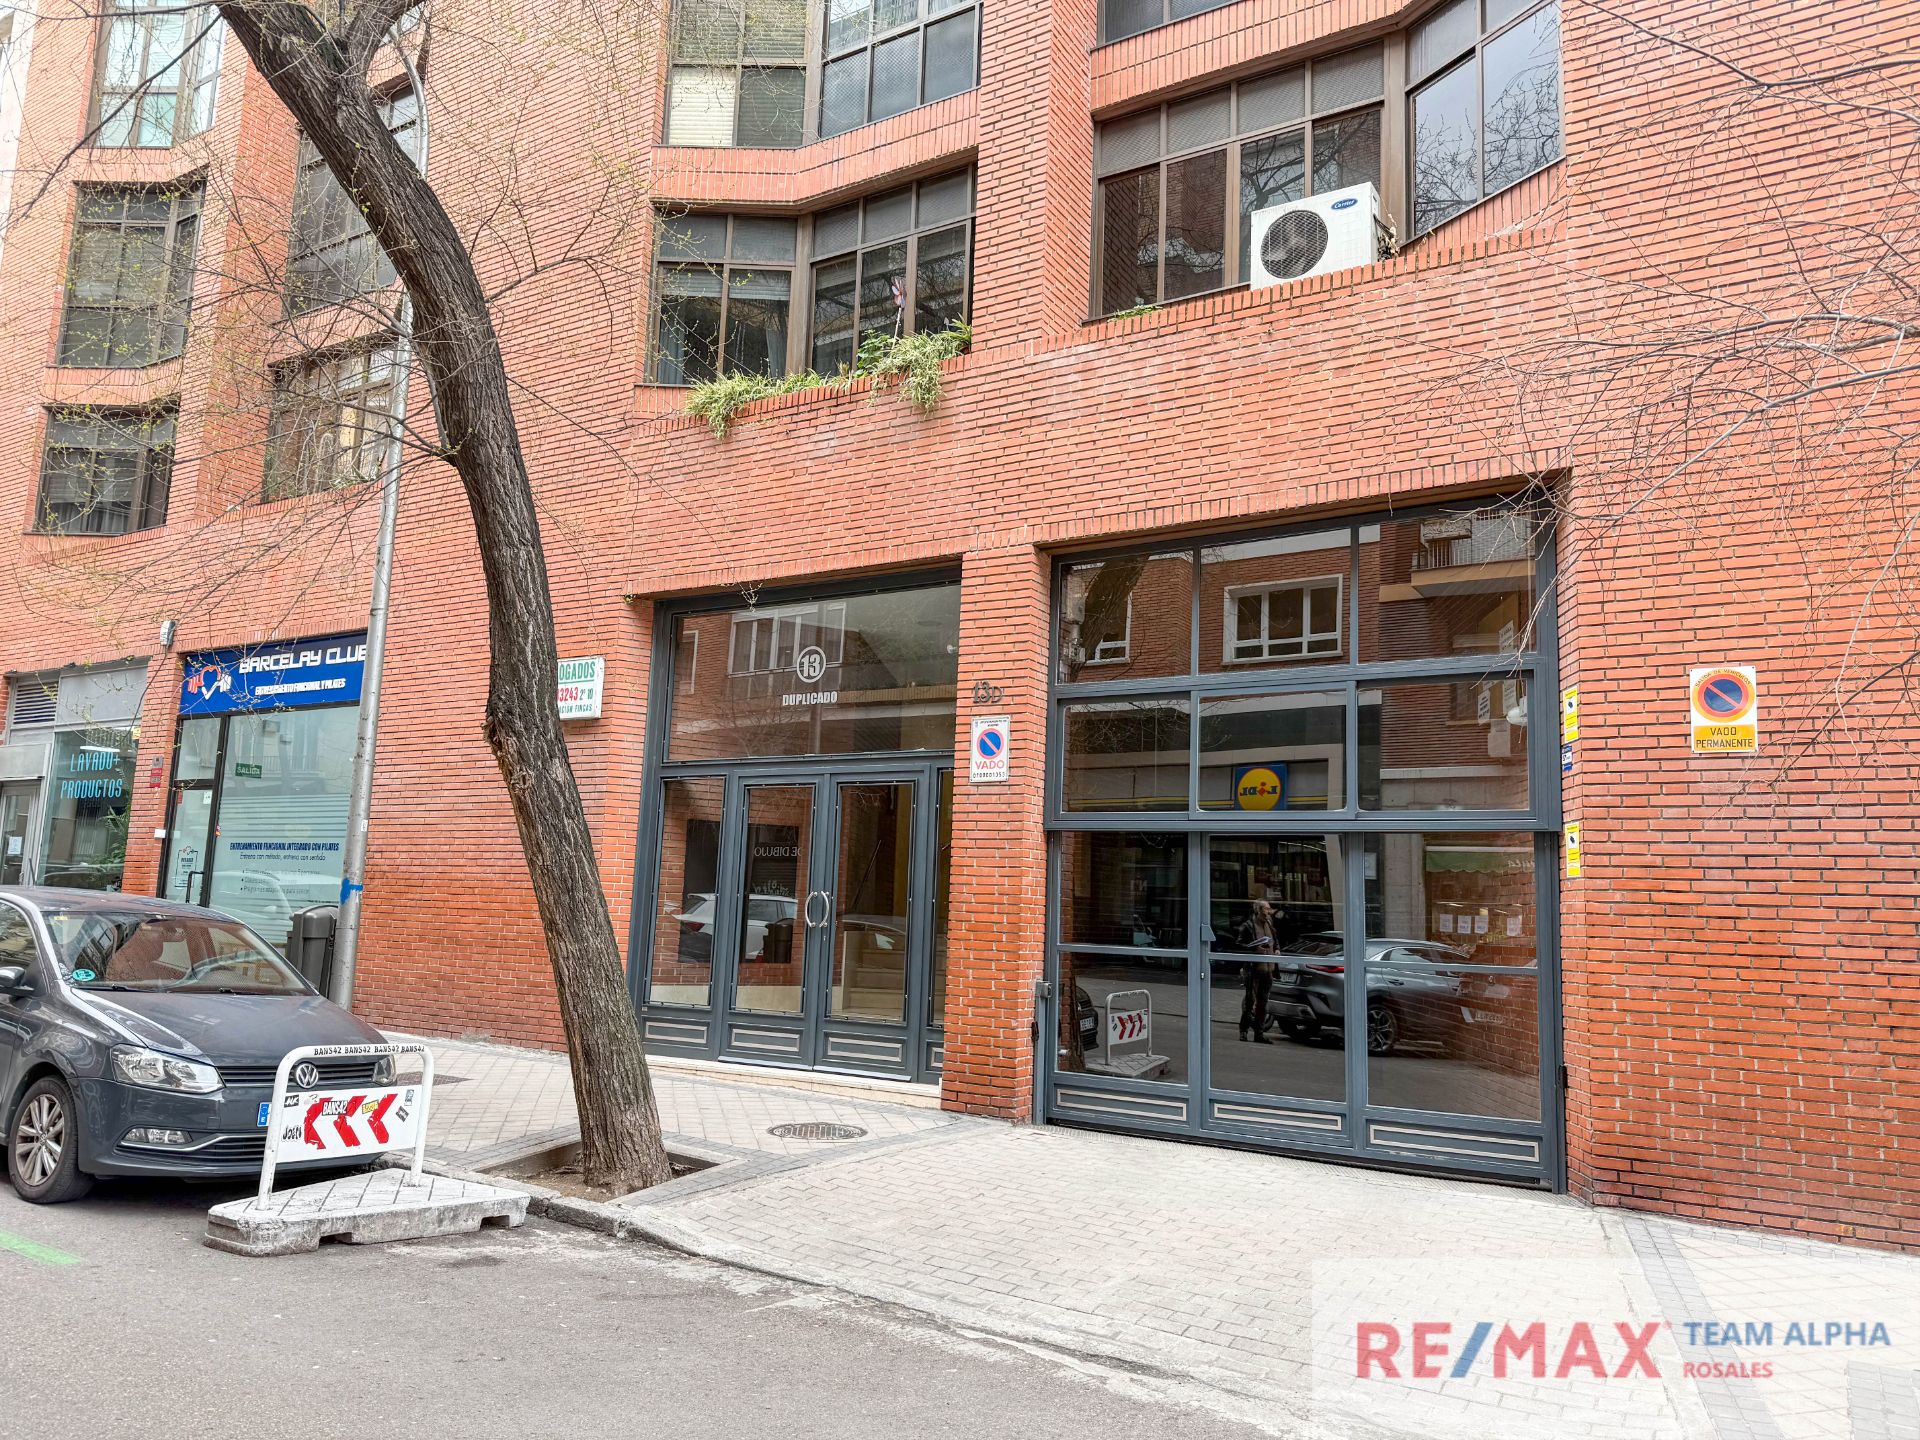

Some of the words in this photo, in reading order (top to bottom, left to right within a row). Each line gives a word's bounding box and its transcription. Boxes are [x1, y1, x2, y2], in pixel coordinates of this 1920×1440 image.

[238, 649, 322, 674] BARCELAY
[800, 654, 823, 677] 13
[559, 661, 596, 680] OGADOS
[557, 687, 579, 702] 3243
[782, 691, 838, 706] DUPLICADO
[1710, 726, 1737, 736] VADO
[1695, 738, 1753, 748] PERMANENTE
[236, 765, 261, 776] SALIDA
[974, 759, 1005, 770] VADO
[60, 778, 123, 800] PRODUCTOS
[322, 1101, 347, 1115] BANS42
